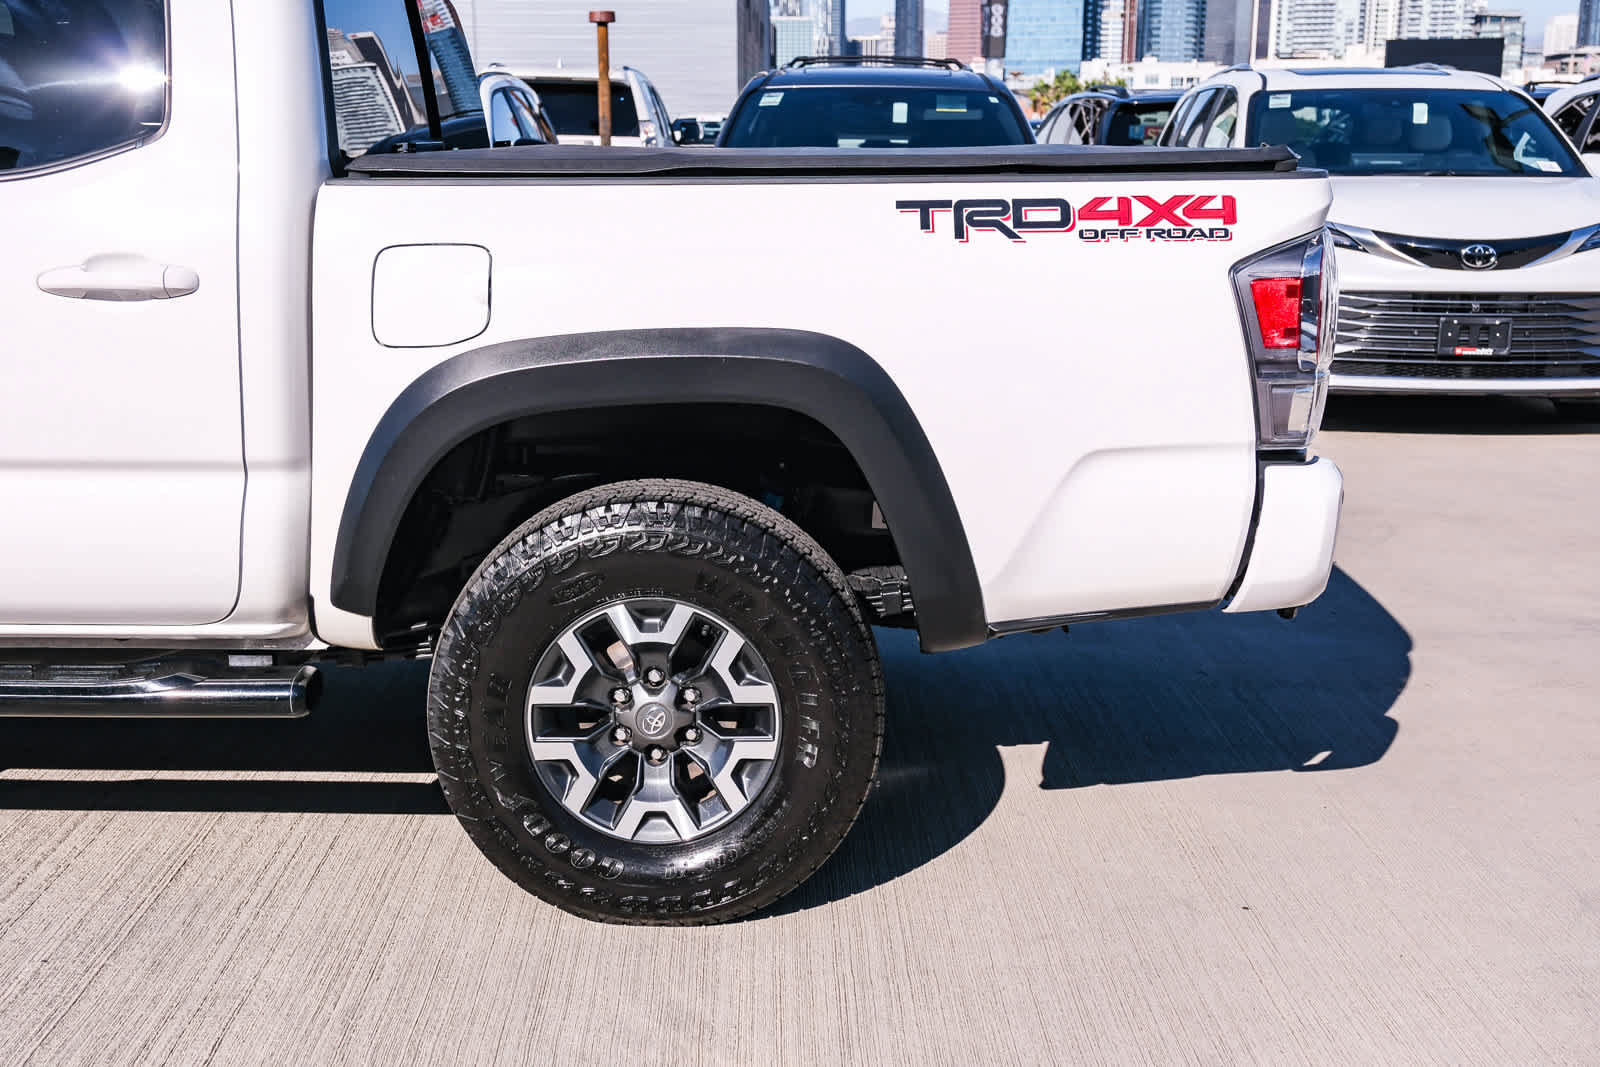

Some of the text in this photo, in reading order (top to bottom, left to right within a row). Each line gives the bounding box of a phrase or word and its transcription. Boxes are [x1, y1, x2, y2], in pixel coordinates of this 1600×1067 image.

[895, 197, 1076, 242] TRD
[1077, 227, 1234, 242] OFF ROAD
